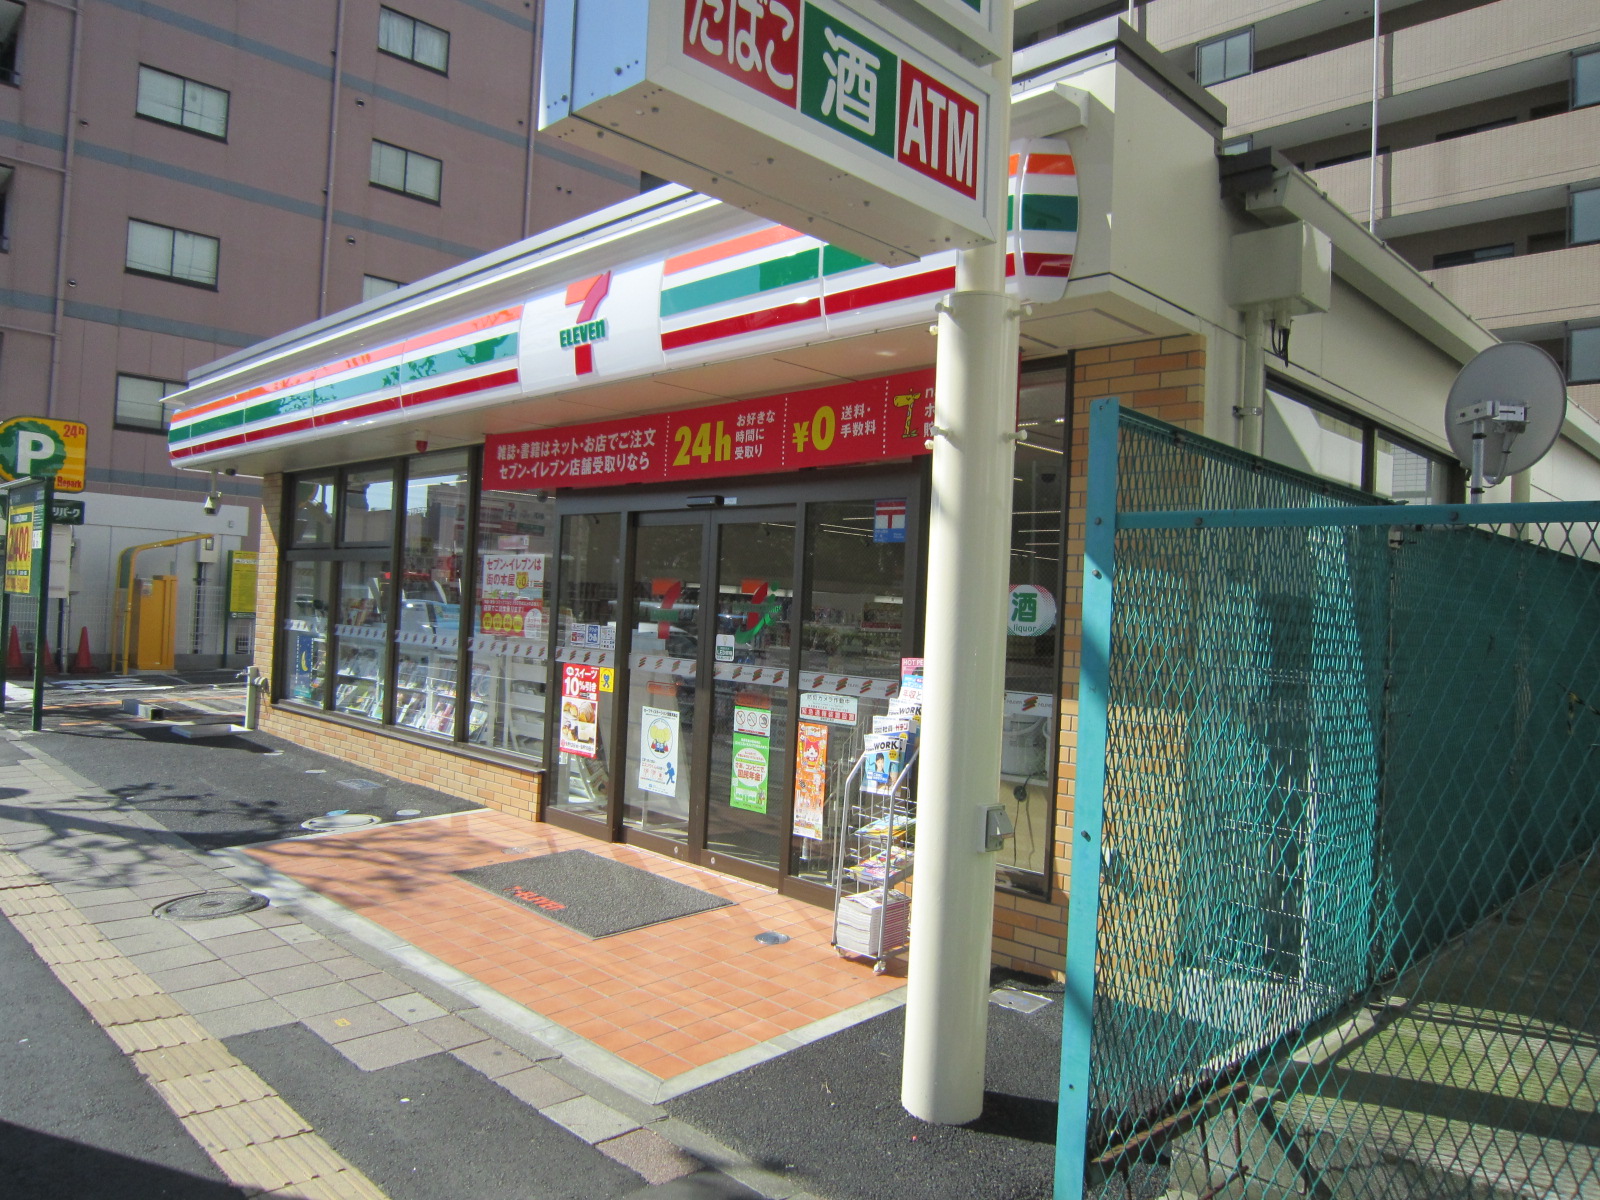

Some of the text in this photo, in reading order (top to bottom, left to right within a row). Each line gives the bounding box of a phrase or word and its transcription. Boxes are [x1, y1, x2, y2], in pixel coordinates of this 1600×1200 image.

[689, 0, 794, 90] たばこ
[821, 27, 880, 136] 酒
[902, 78, 974, 188] ATM
[736, 410, 776, 427] お好きな
[63, 424, 85, 438] 24h
[735, 428, 765, 443] 時間に
[792, 405, 836, 453] ¥0
[840, 420, 876, 438] 手数料
[673, 420, 732, 466] 24h
[17, 430, 55, 474] P
[735, 444, 763, 460] 受取り
[53, 507, 80, 518] リパーク
[1011, 591, 1038, 622] 酒
[1013, 624, 1037, 633] liquor
[574, 668, 598, 679] スイーツ
[899, 706, 921, 716] WORK
[873, 740, 899, 751] WORK
